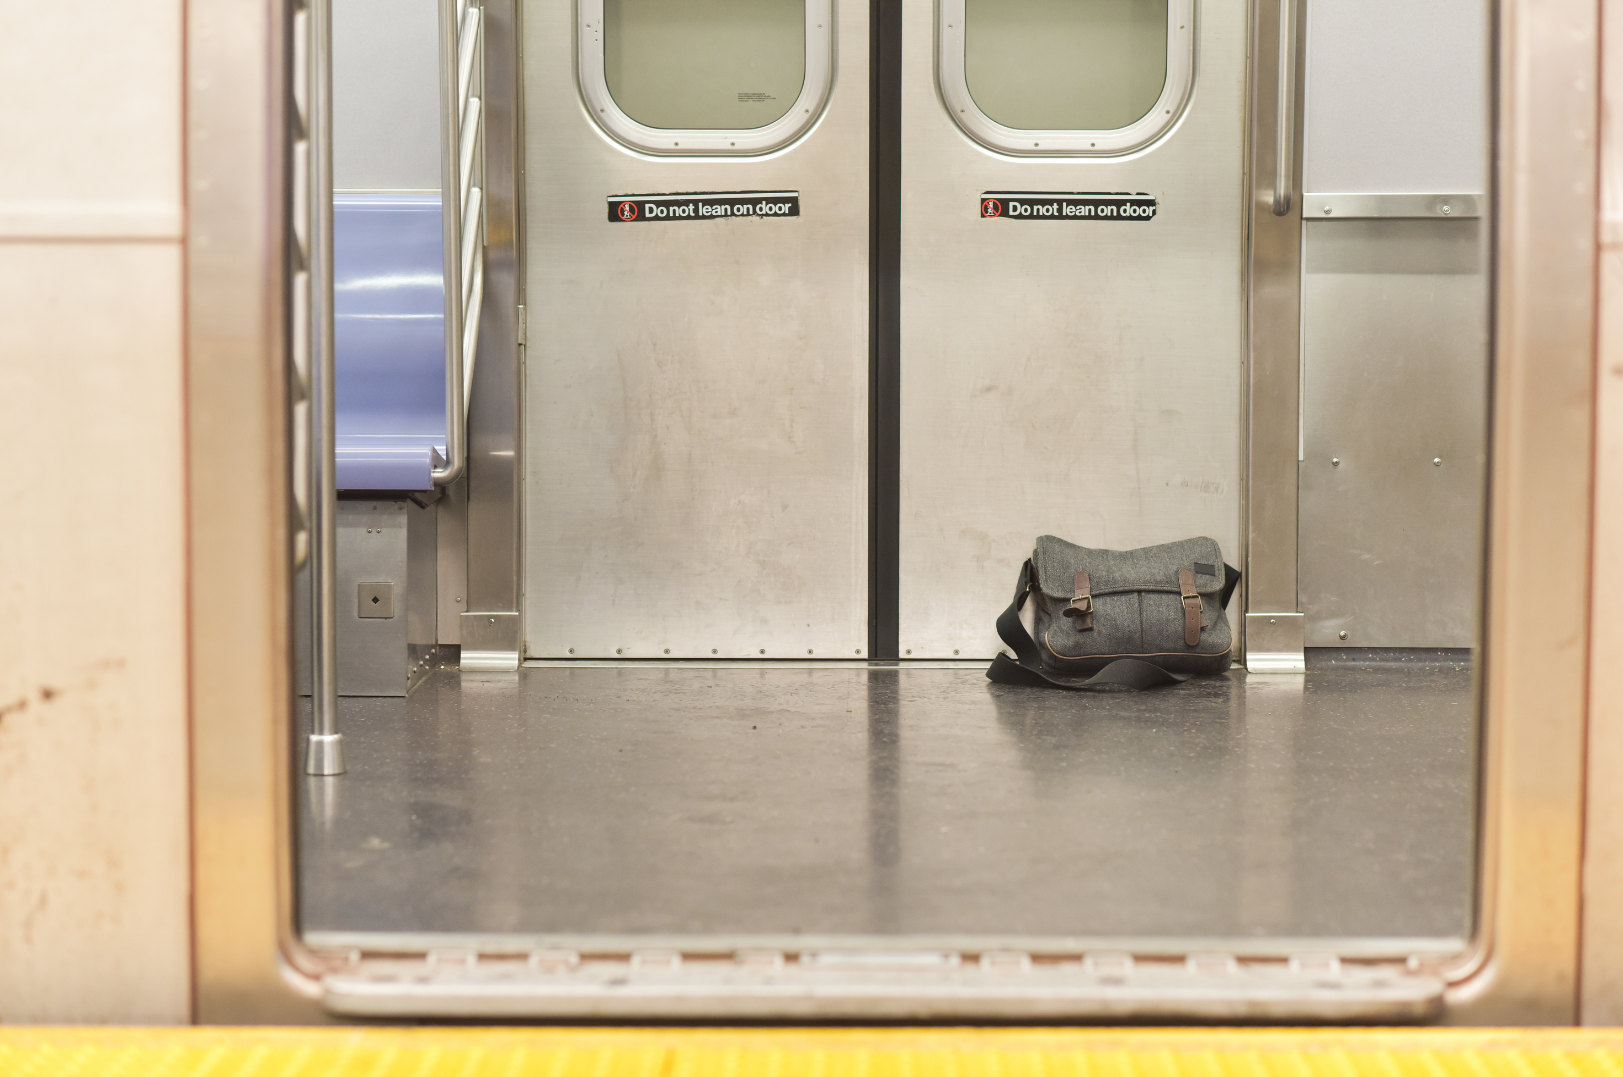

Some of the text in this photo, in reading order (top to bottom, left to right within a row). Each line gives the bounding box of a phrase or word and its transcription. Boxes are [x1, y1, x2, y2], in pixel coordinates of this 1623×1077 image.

[645, 201, 791, 217] Do not lean on door
[1008, 201, 1156, 216] Do not lean on door
